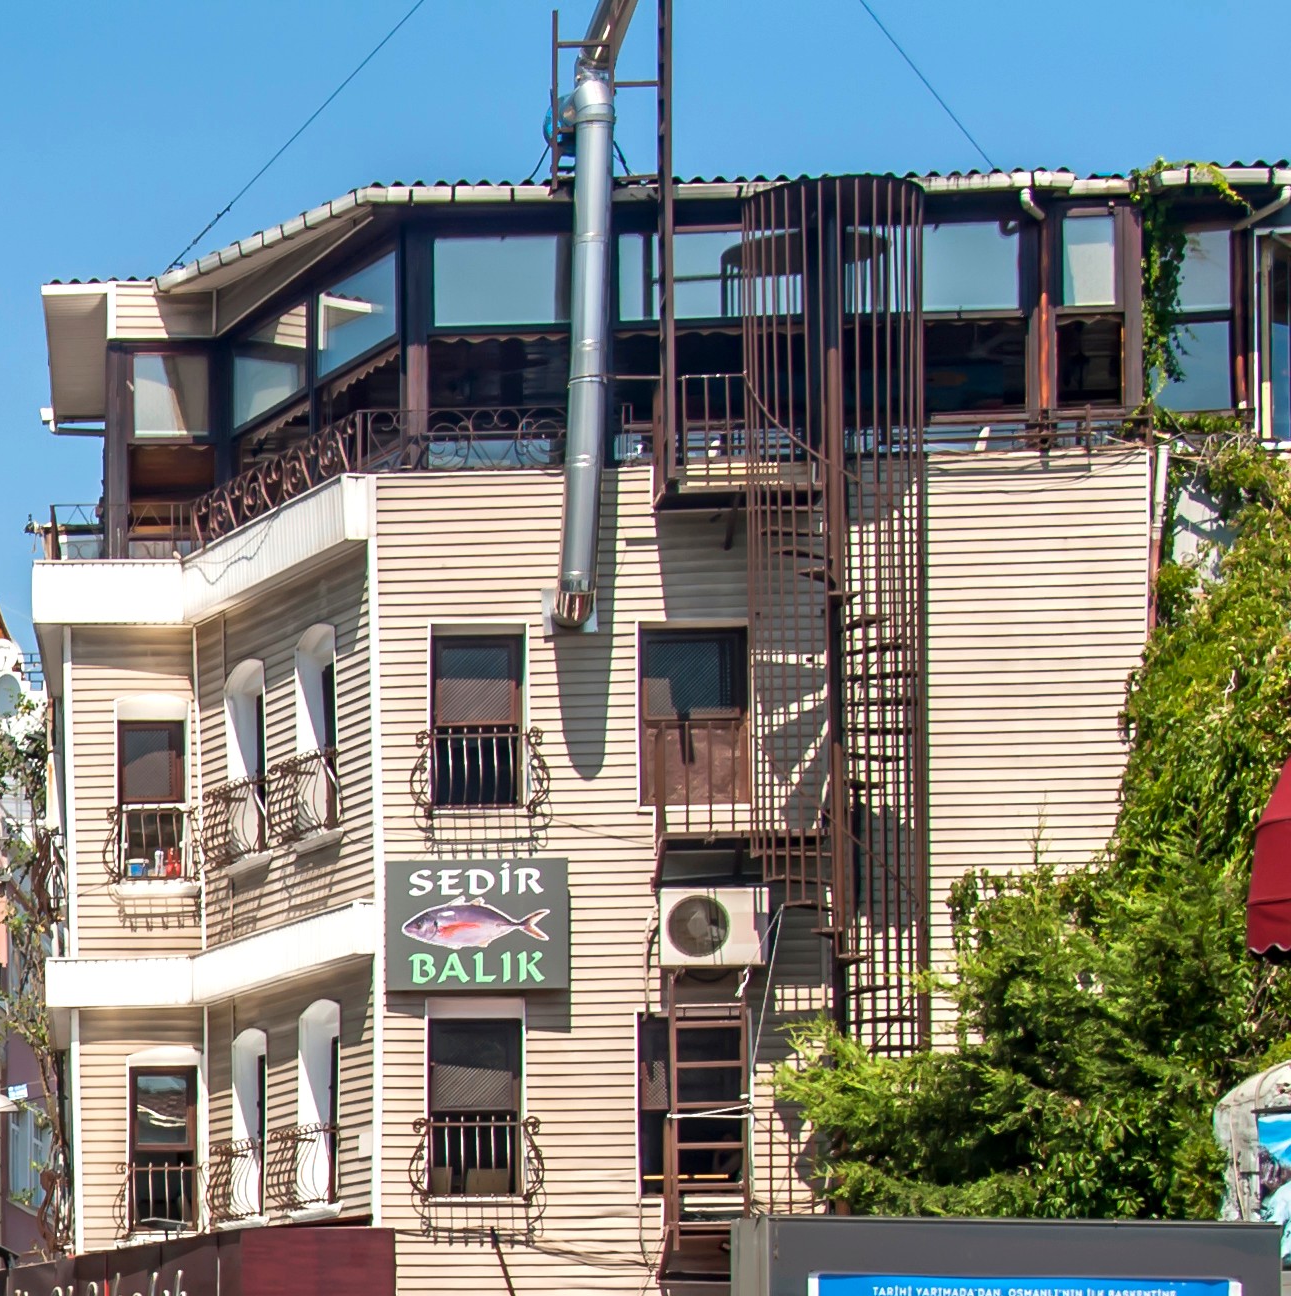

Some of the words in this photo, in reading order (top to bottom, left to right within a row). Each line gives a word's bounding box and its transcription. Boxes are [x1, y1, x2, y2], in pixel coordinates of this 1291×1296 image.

[408, 861, 545, 897] SEDİR
[408, 951, 546, 985] BALIK
[872, 1285, 912, 1296] TARİHİ
